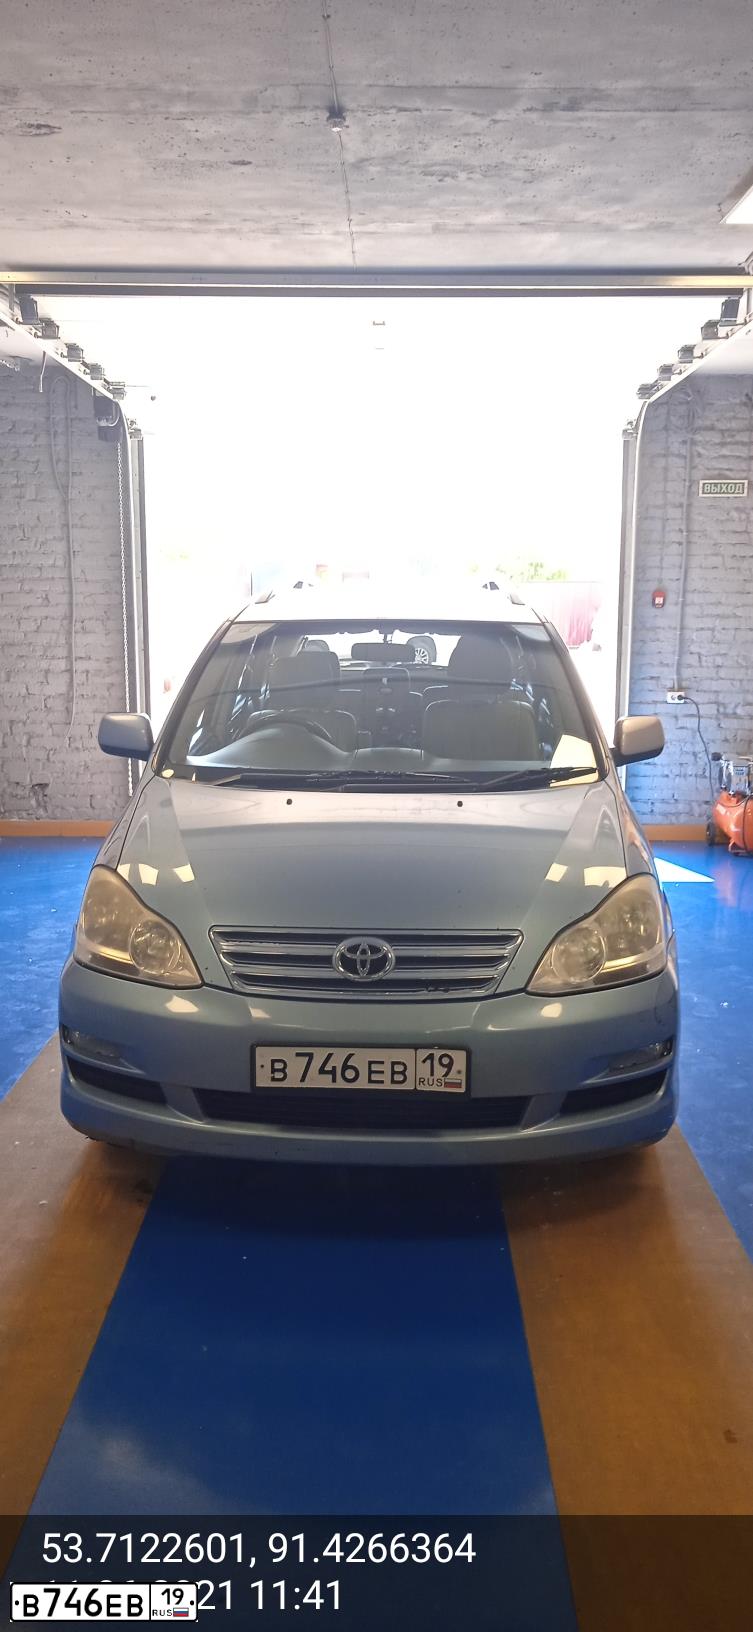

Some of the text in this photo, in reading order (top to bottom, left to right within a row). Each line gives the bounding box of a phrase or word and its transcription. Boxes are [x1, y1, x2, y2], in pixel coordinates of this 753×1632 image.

[703, 483, 743, 494] ВЫХОД
[421, 1052, 455, 1078] 19
[418, 1077, 443, 1087] RUS
